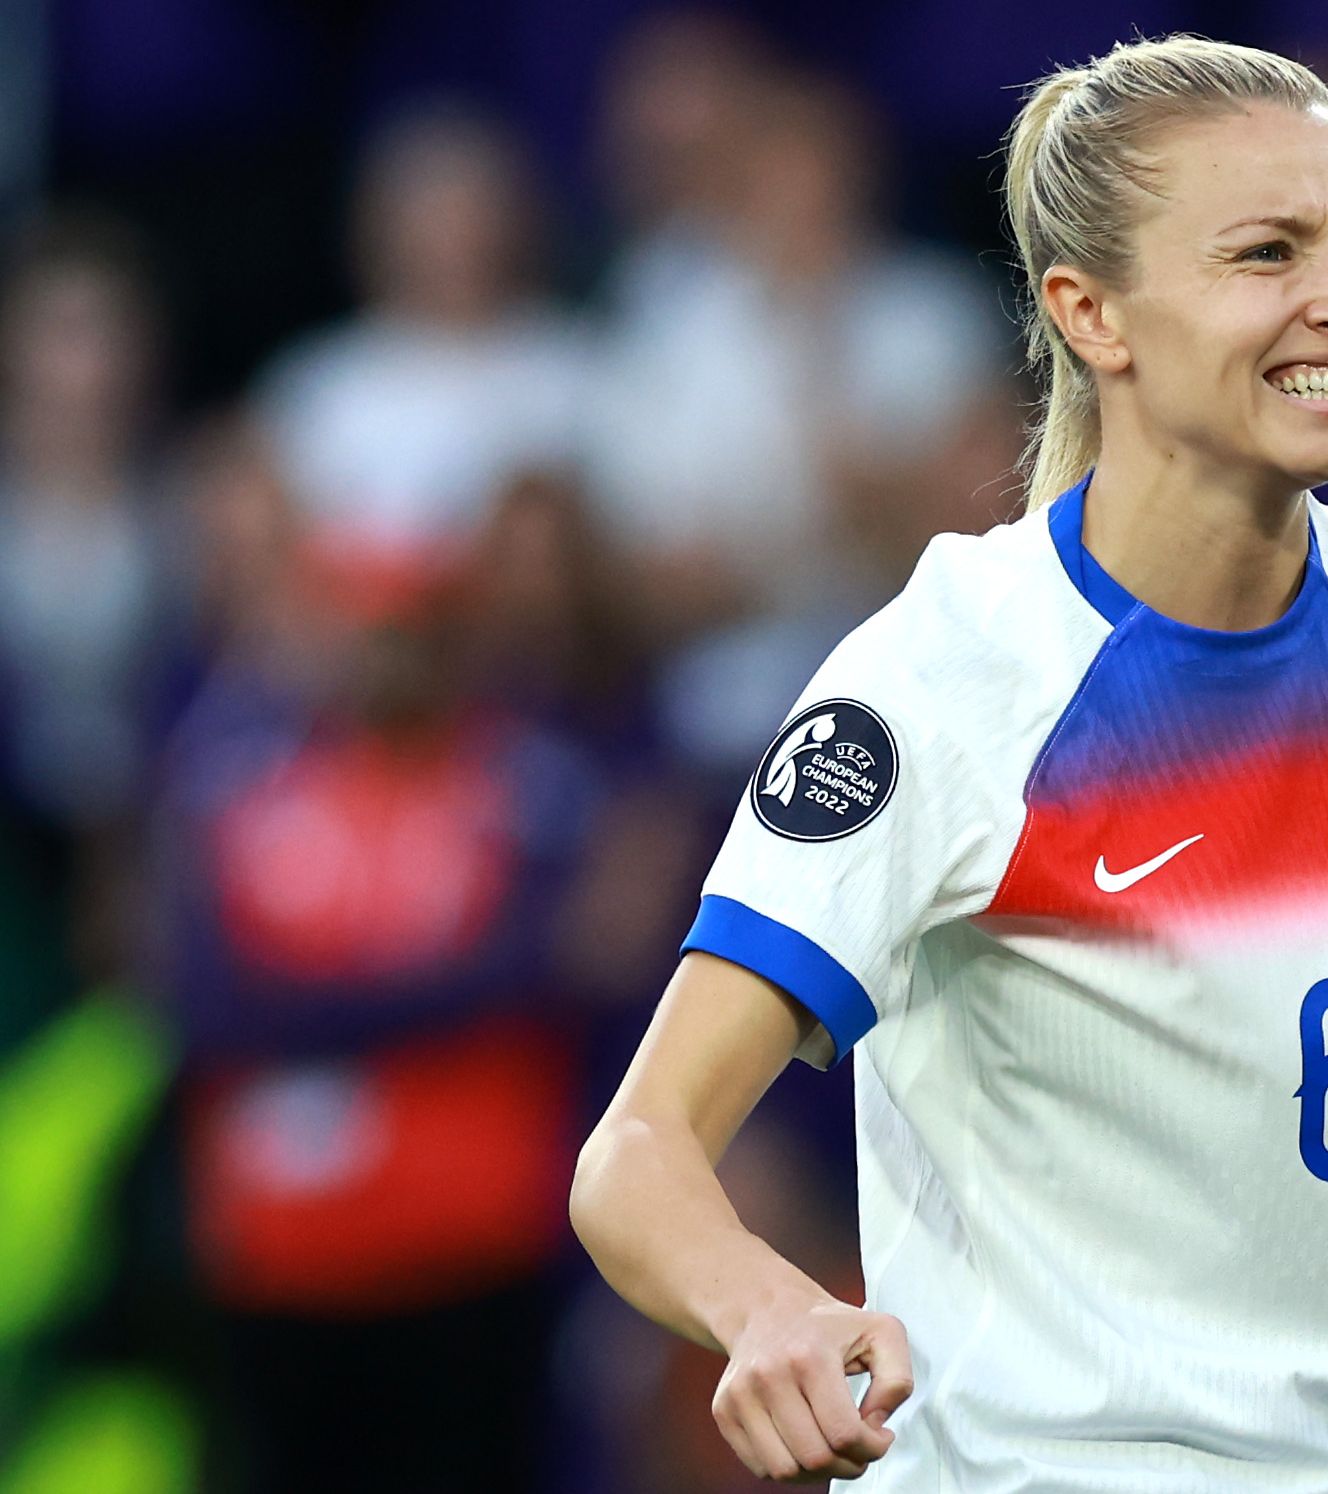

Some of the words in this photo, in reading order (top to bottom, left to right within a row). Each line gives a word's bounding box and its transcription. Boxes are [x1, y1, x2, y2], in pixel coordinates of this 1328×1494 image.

[811, 753, 878, 793] EUROPEAN
[835, 746, 871, 770] UEFA
[801, 765, 874, 807] CHAMPIONS
[804, 785, 850, 815] 2022
